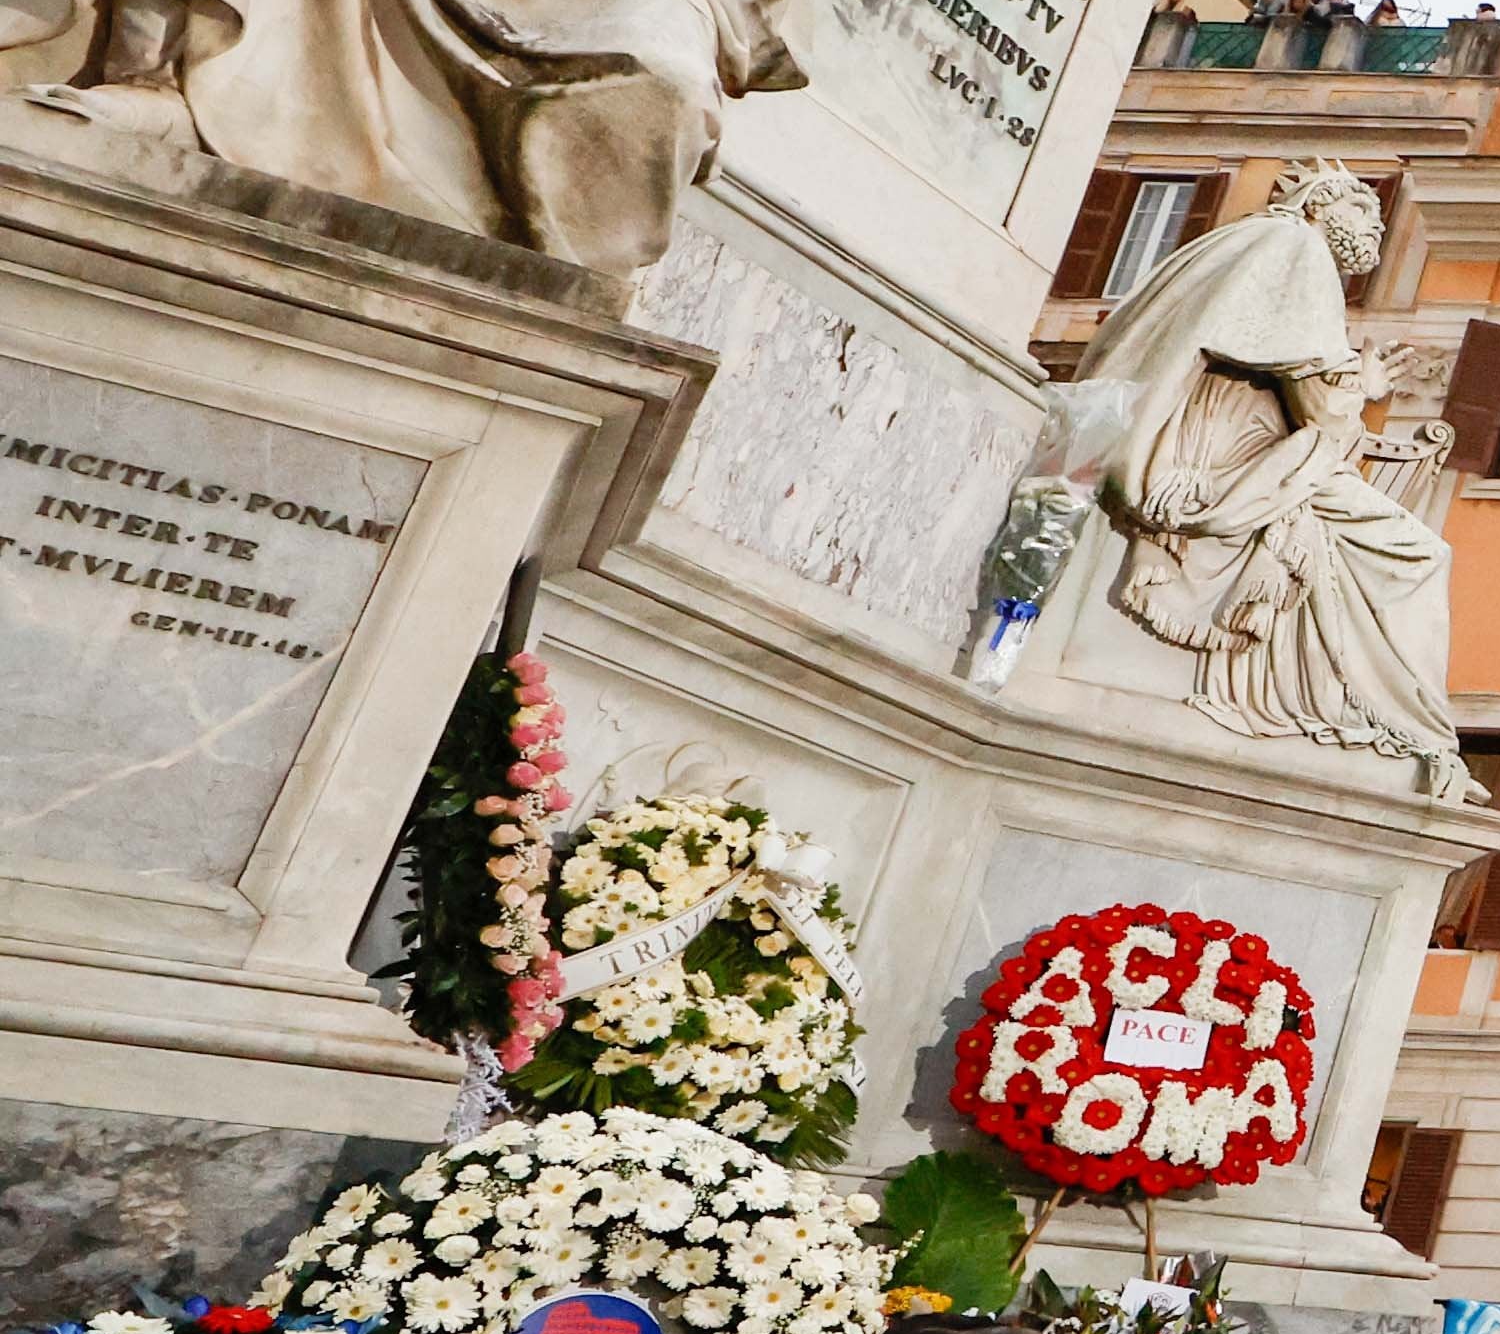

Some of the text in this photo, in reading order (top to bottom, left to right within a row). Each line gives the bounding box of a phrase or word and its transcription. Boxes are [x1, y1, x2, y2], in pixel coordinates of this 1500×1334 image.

[930, 54, 980, 104] LVC
[35, 495, 260, 561] INTER TE
[245, 492, 400, 544] PONAM
[34, 545, 297, 617] MVLIEREM
[131, 612, 202, 636] GEN
[1008, 924, 1288, 1051] ACLI
[1121, 1018, 1197, 1045] PACE
[979, 1020, 1298, 1169] ROMA
